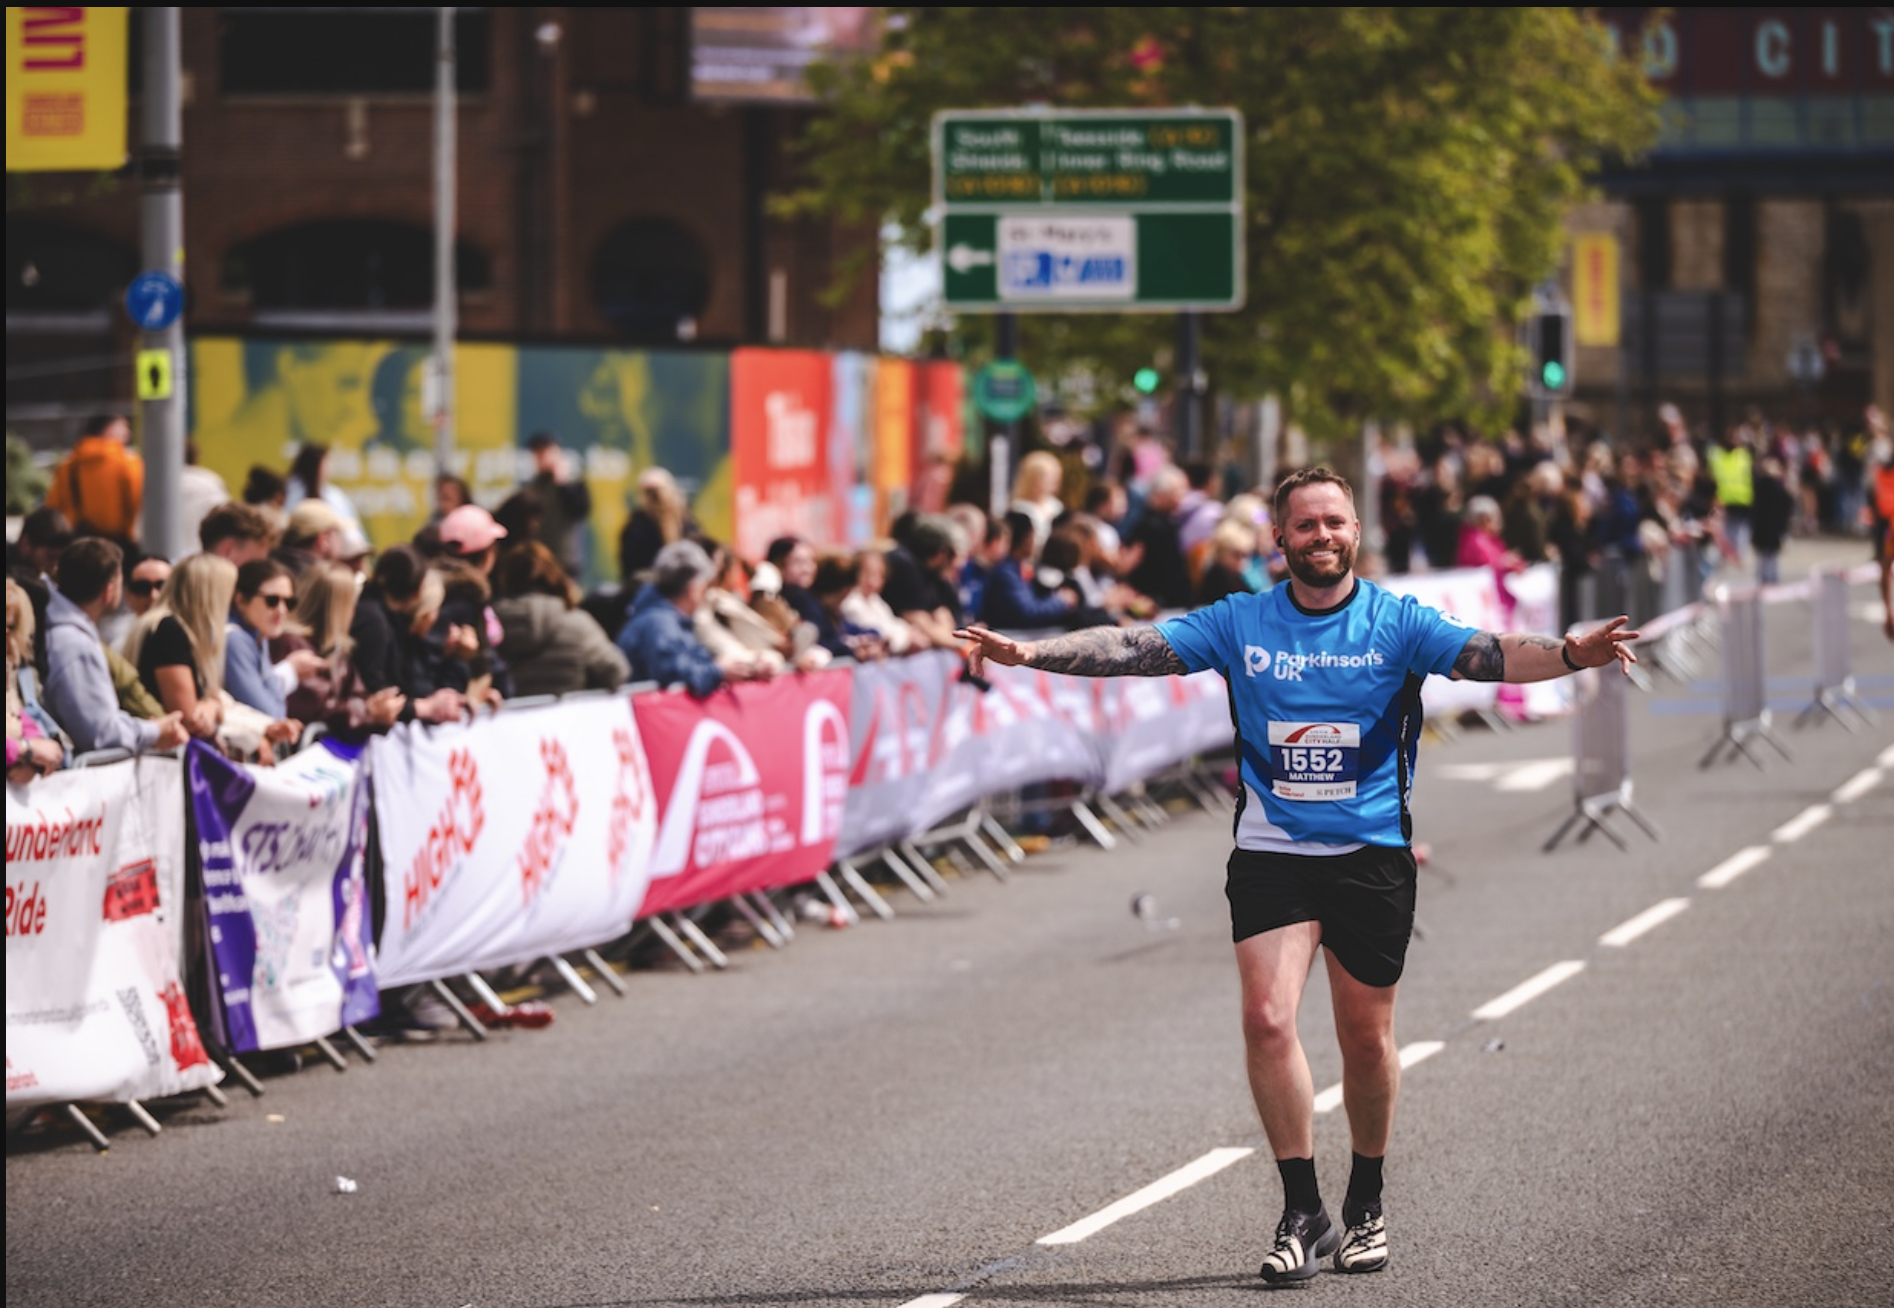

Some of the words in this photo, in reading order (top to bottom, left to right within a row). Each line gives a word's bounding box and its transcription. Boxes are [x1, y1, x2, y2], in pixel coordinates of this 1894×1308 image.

[1275, 648, 1384, 668] Parkinson's
[1274, 664, 1303, 682] UK
[1281, 748, 1344, 772] 1552
[1288, 773, 1336, 782] MATTHEW
